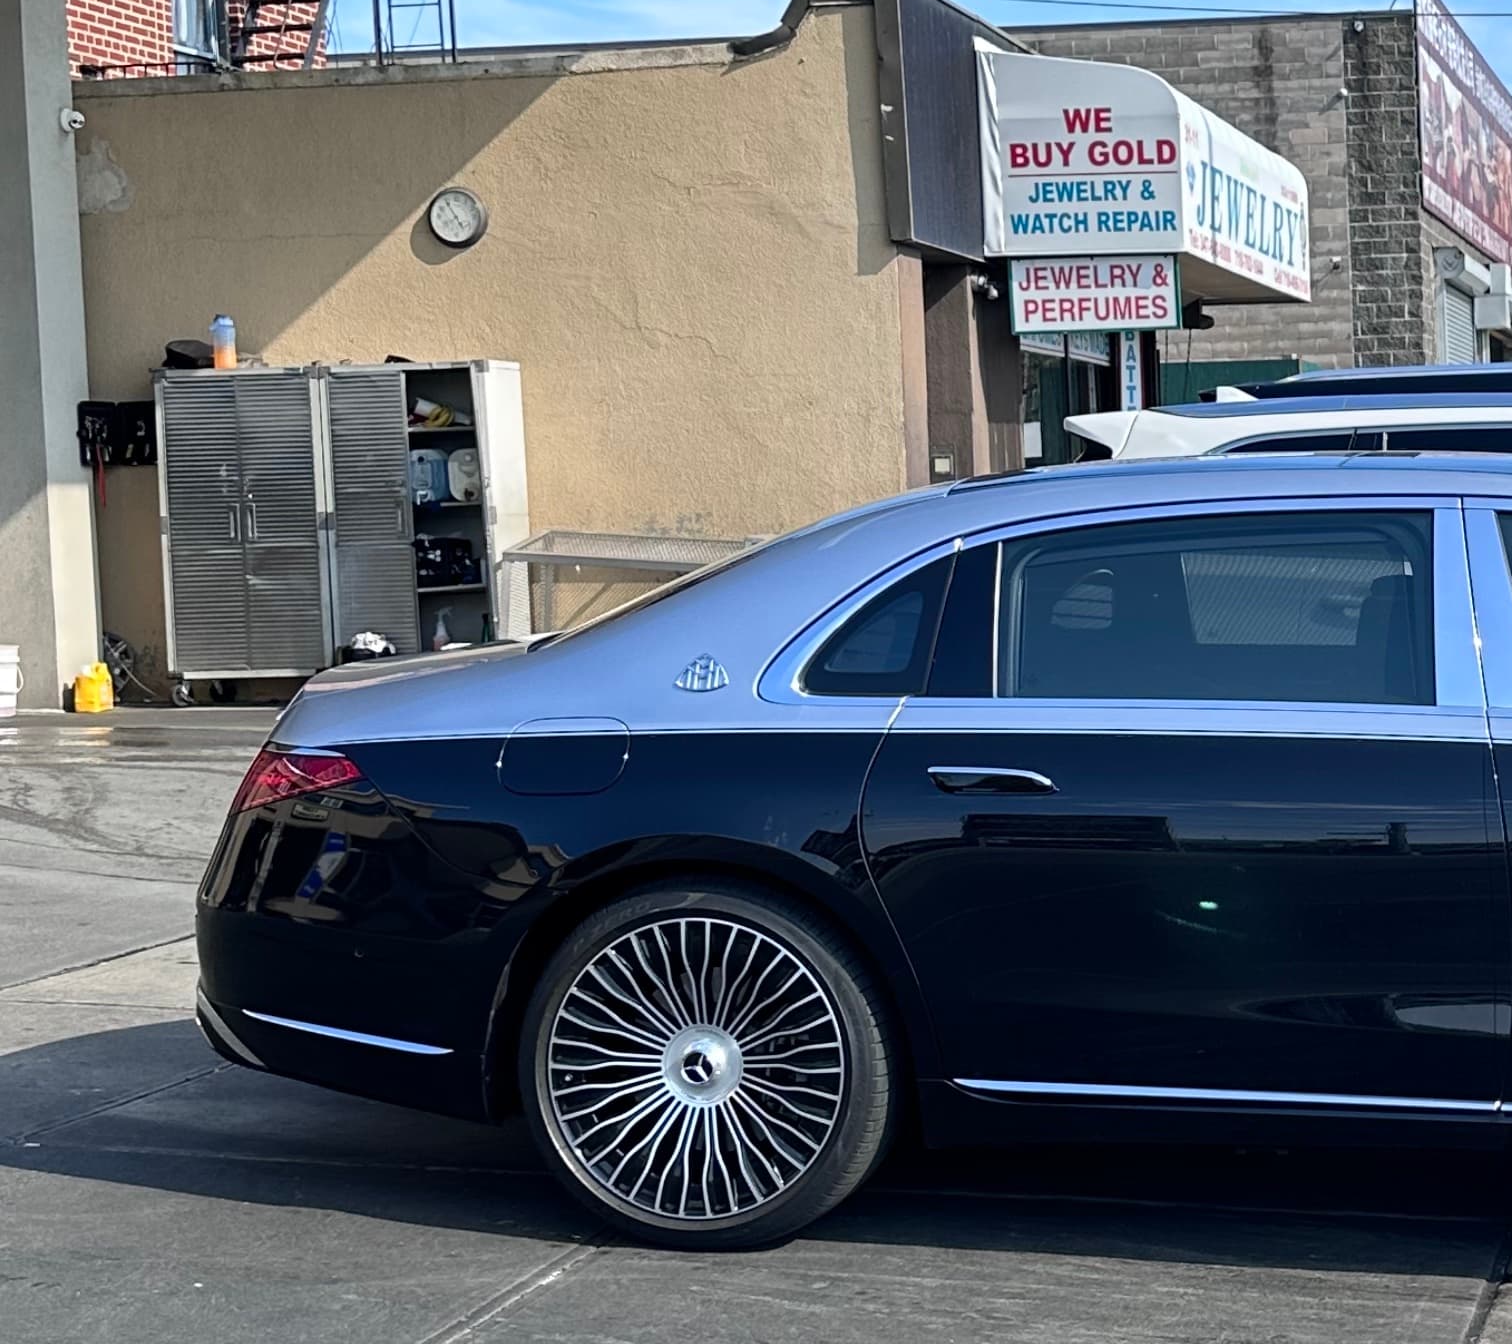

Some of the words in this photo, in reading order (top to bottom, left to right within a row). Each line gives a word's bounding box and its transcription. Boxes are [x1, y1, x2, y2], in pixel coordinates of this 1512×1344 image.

[1063, 107, 1113, 134] WE
[1009, 141, 1076, 169] BUY
[1088, 139, 1177, 167] GOLD
[1028, 179, 1132, 204] JEWELRY
[1140, 179, 1156, 201] &
[1010, 212, 1089, 235] WATCH
[1097, 210, 1177, 233] REPAIR
[1197, 160, 1299, 267] JEWELRY
[1018, 263, 1143, 292] JEWELRY
[1152, 262, 1169, 288] &
[1024, 295, 1168, 323] PERFUMES
[1125, 330, 1137, 411] BATT
